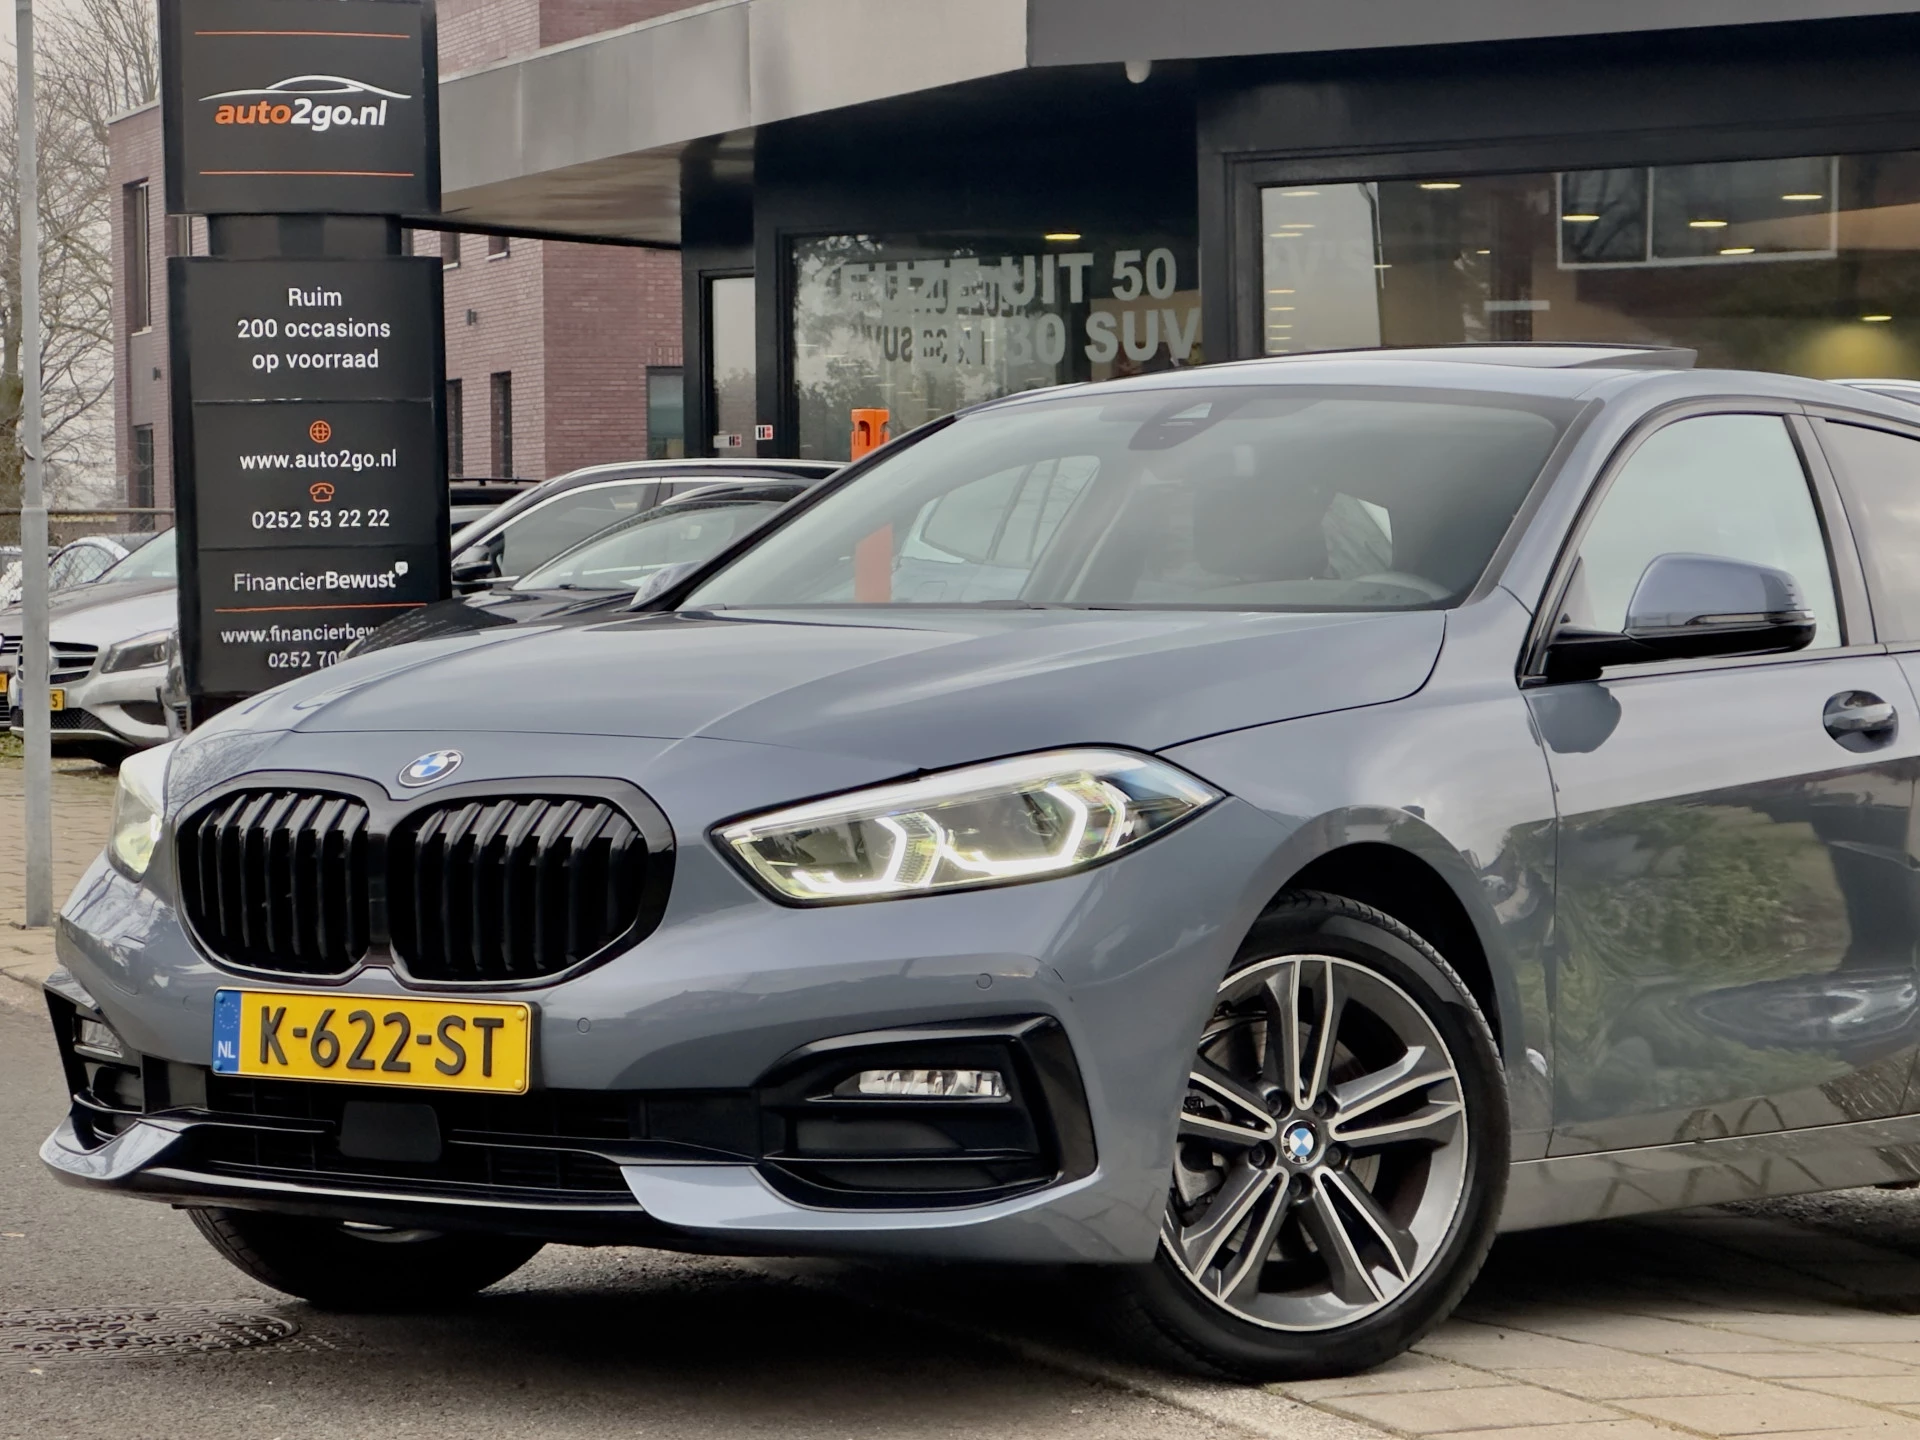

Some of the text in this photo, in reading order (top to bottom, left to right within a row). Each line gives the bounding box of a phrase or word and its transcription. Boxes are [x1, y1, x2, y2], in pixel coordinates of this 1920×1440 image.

[215, 98, 387, 131] auto2go.nl
[1000, 252, 1094, 306] UIT
[1112, 248, 1177, 301] 50
[288, 287, 342, 306] Ruim
[237, 318, 391, 338] 200 occasions
[252, 349, 379, 373] op voorraad
[240, 449, 397, 472] www.auto2go.nl
[252, 509, 390, 529] 0252 53 22 22
[234, 570, 396, 592] FinancierBewust
[221, 623, 378, 645] www.financierbew
[268, 651, 312, 668] 0252
[217, 1041, 236, 1059] NL
[259, 1005, 504, 1077] K-622-ST
